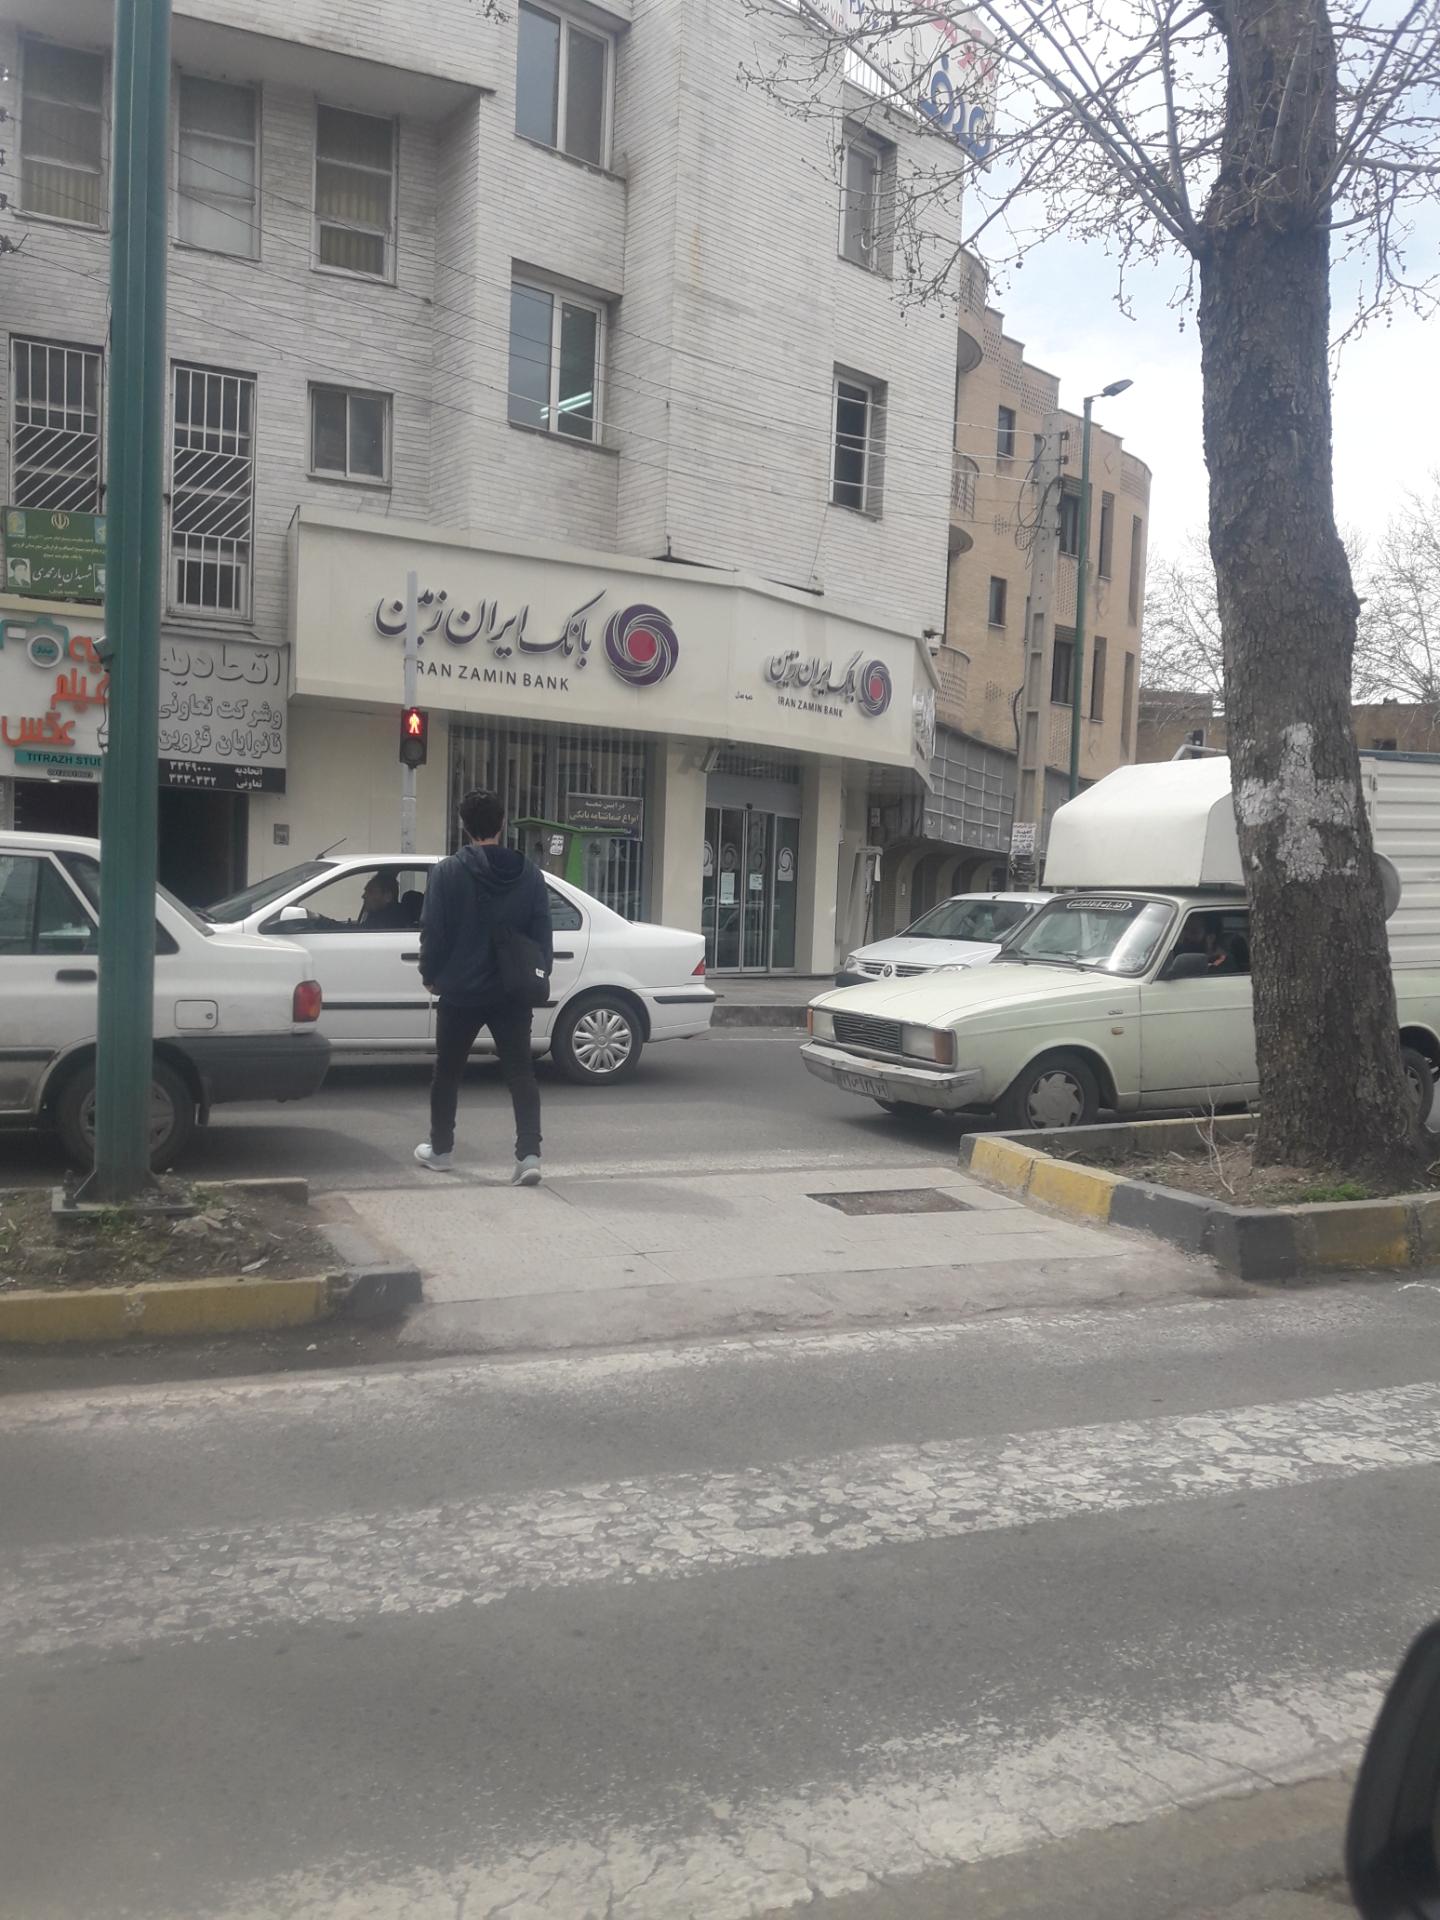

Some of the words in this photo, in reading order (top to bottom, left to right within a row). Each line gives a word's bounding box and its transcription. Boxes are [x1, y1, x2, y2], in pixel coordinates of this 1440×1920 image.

[445, 599, 530, 658] ایران
[519, 588, 607, 667] بانک
[405, 658, 451, 678] RAN
[458, 665, 517, 686] ZAMIN
[523, 671, 569, 691] BANK
[777, 695, 796, 708] IRAN
[797, 700, 823, 714] ZAMIN
[823, 705, 844, 718] BANK
[1, 711, 76, 747] عکس
[27, 752, 73, 764] TITRAZH
